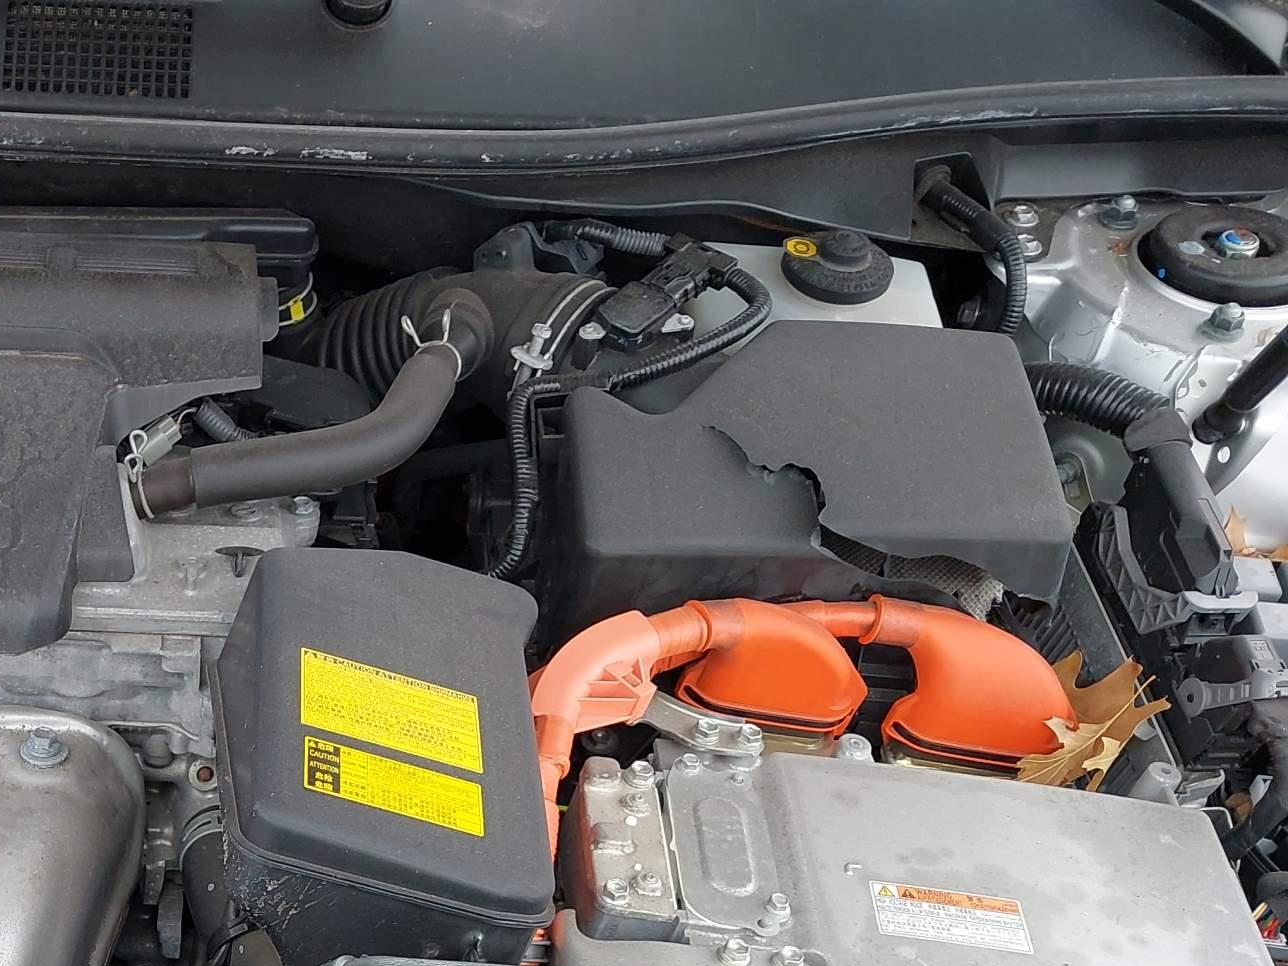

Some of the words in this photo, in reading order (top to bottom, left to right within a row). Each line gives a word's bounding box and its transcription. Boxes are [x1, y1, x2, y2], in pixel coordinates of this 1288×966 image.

[336, 658, 376, 675] CAUTION
[378, 670, 429, 691] ATTENTION
[309, 749, 340, 763] CAUTION
[309, 760, 339, 774] ATTENTION
